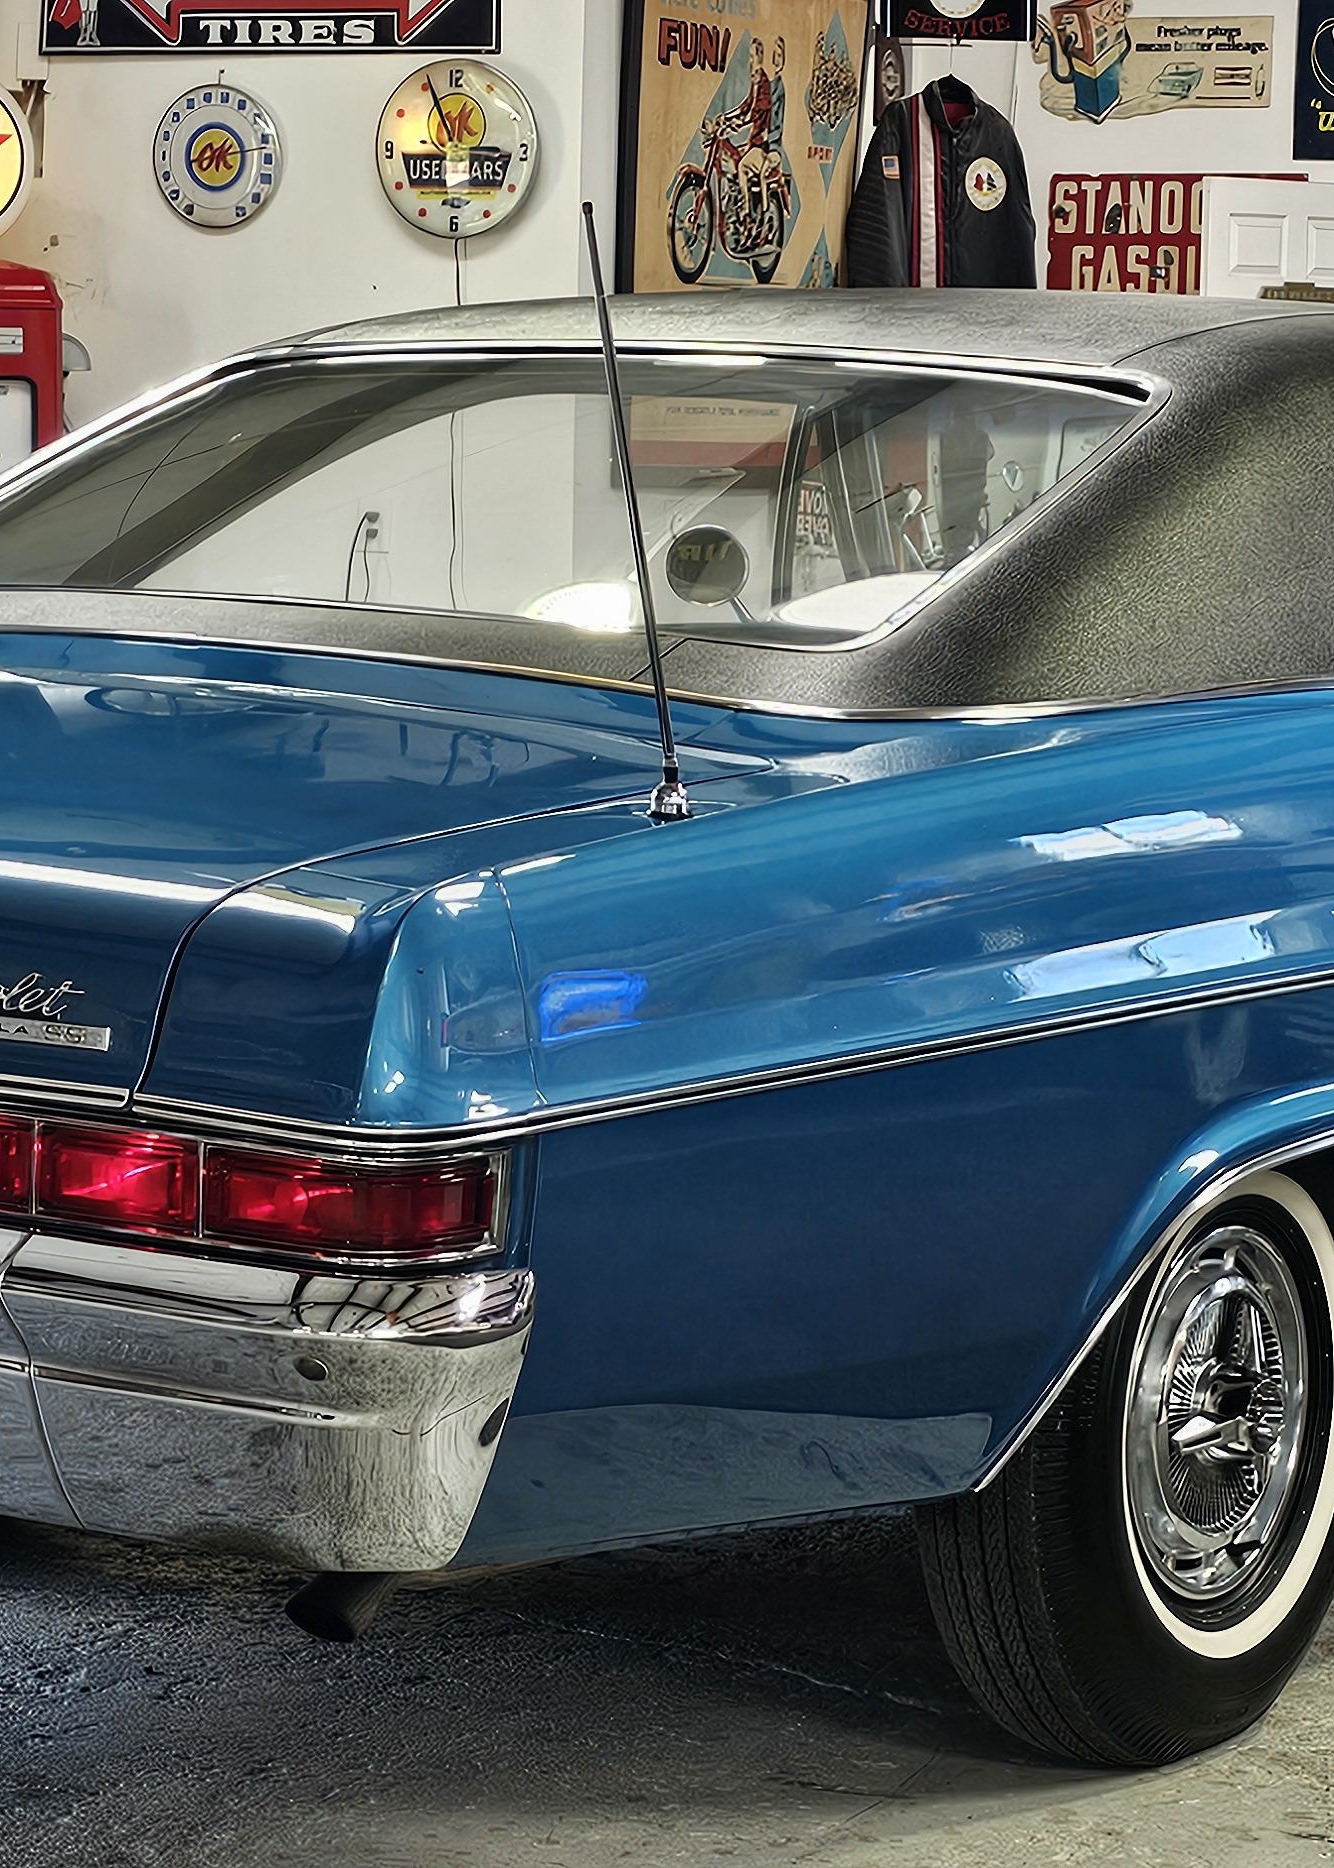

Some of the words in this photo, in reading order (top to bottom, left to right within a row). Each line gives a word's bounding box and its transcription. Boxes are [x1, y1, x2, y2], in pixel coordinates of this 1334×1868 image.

[199, 19, 375, 45] TIRES
[903, 9, 1010, 37] SERVICE
[449, 70, 463, 88] 12
[384, 141, 394, 159] 9
[409, 159, 446, 180] USE
[471, 160, 503, 180] ARS
[449, 216, 458, 232] 6
[43, 1024, 86, 1044] SS
